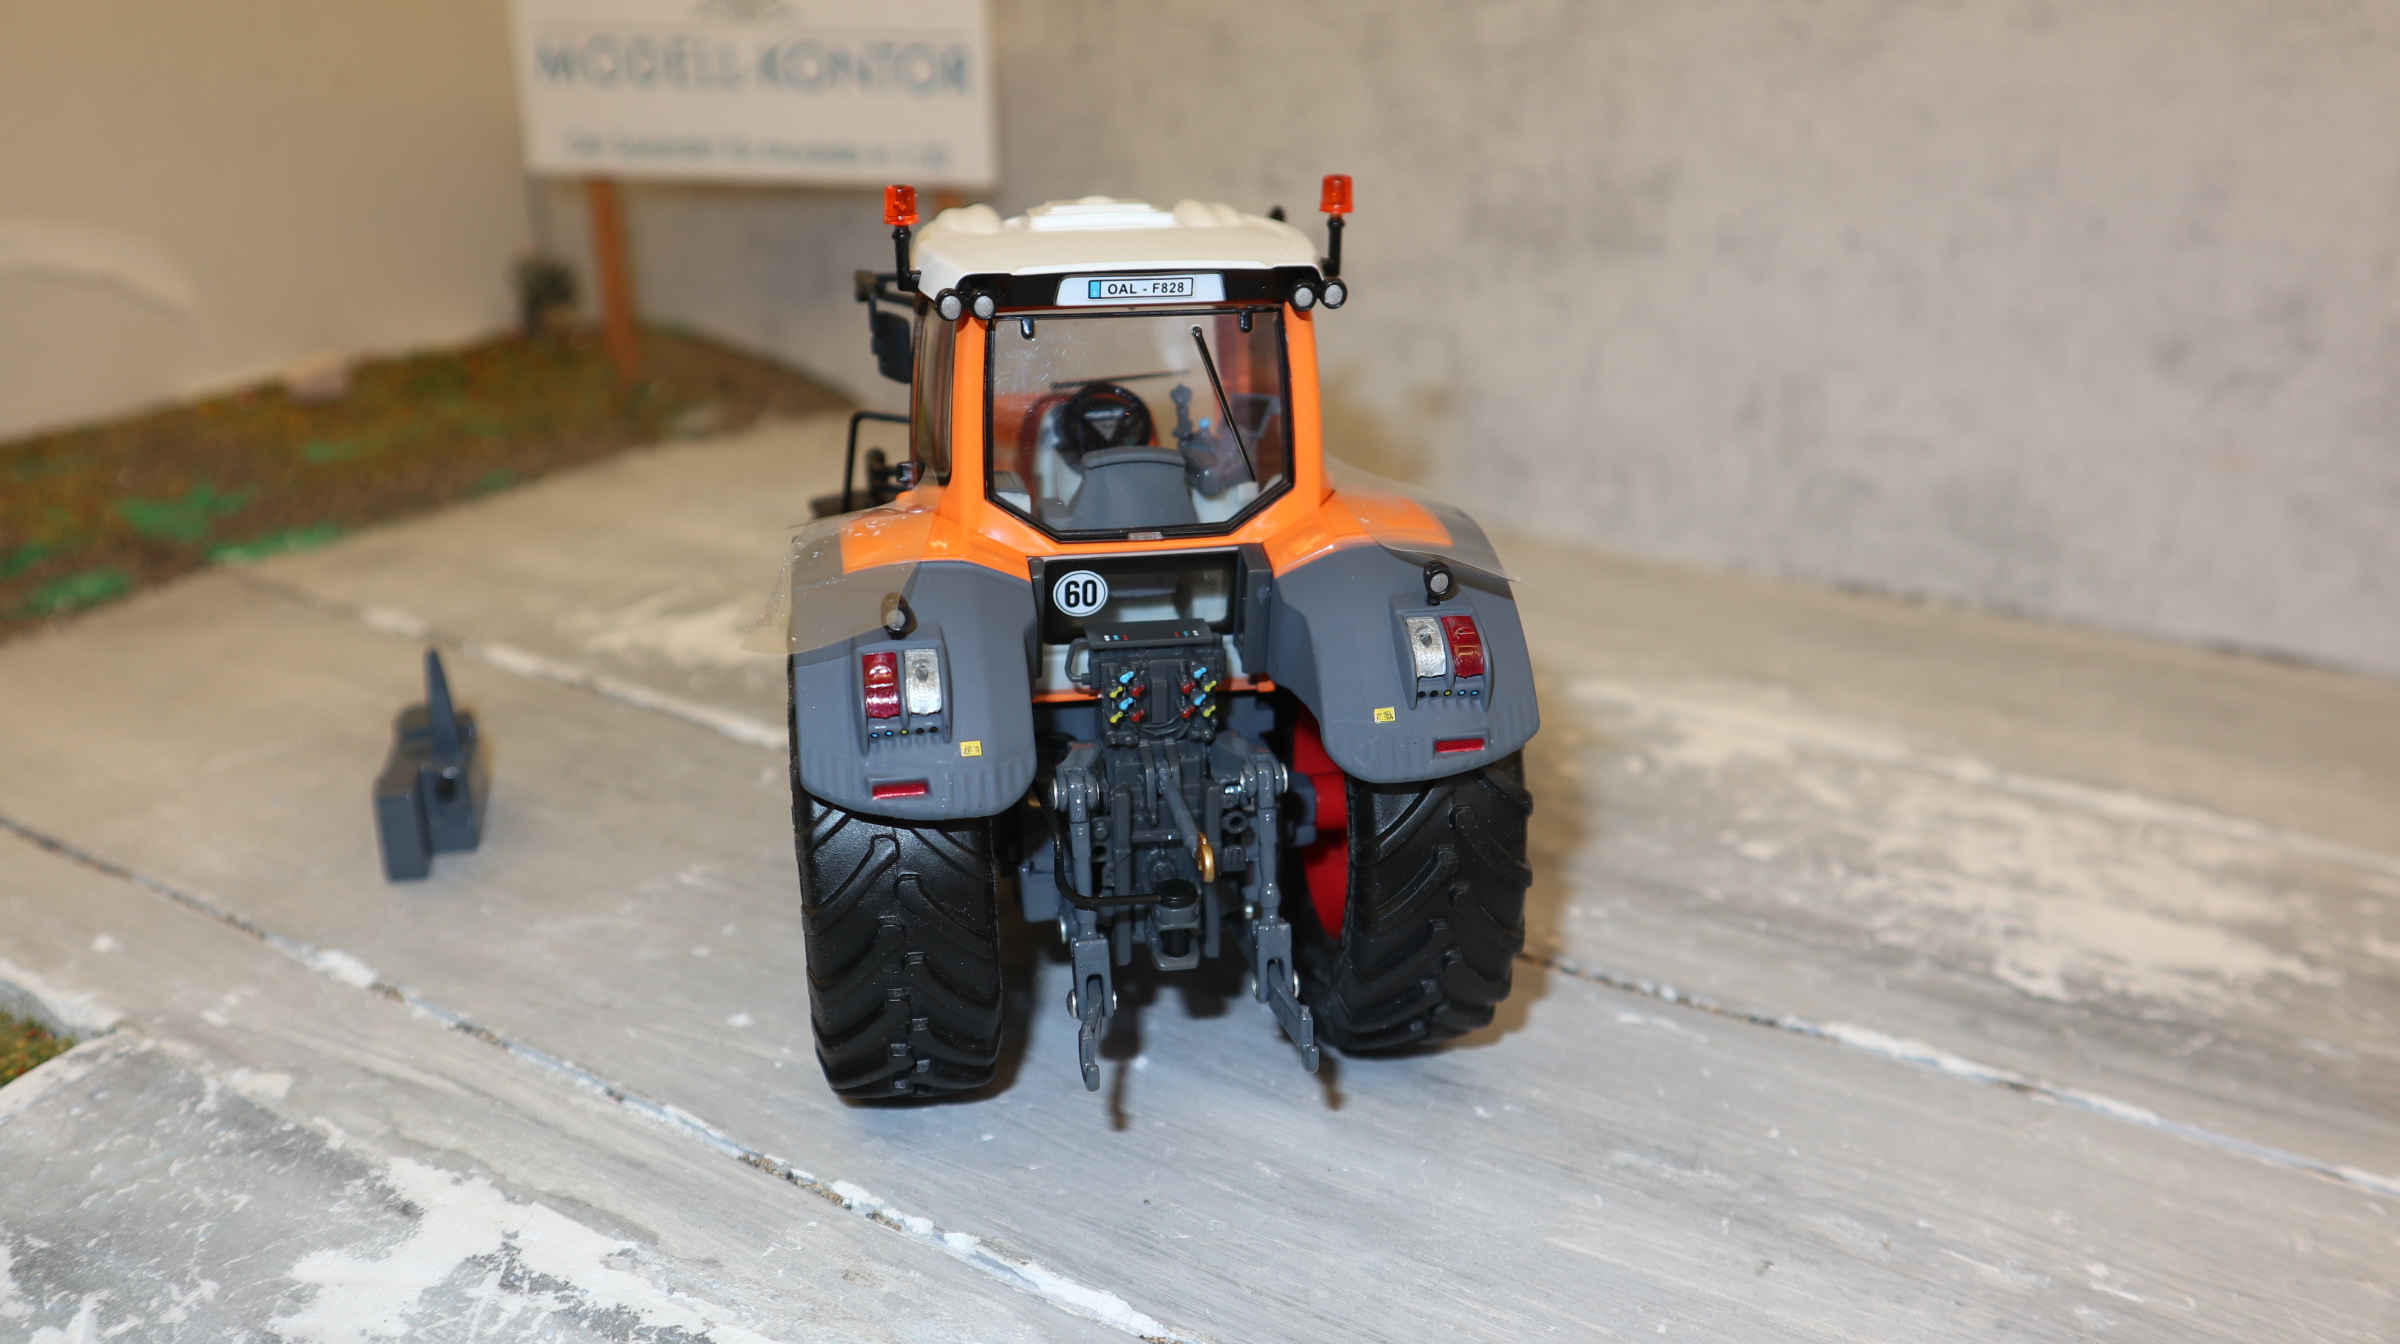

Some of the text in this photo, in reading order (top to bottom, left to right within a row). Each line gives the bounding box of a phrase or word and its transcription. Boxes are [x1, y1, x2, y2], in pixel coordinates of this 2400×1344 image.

[1108, 283, 1137, 294] OAL
[1152, 282, 1184, 294] F828
[1064, 579, 1098, 608] 60
